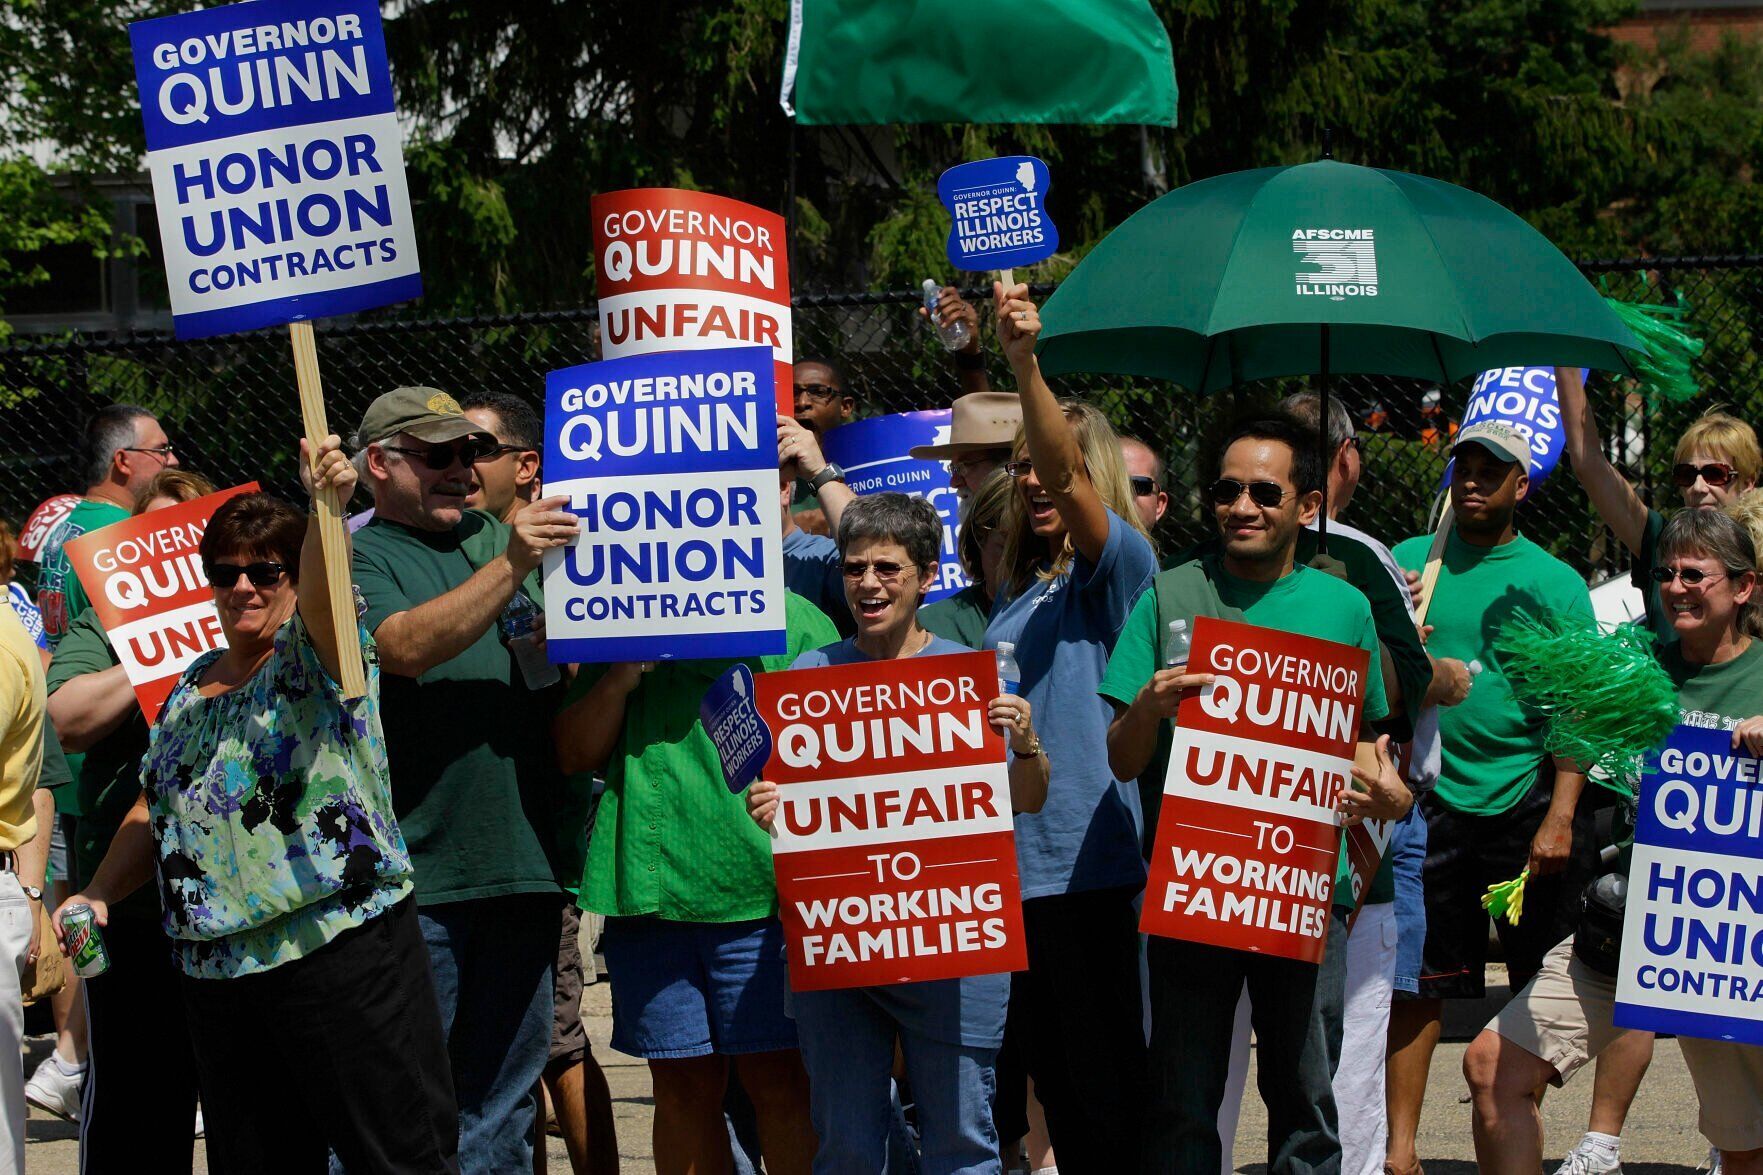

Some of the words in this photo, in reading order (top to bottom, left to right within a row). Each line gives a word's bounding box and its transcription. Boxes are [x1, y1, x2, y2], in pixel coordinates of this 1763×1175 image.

[153, 14, 363, 70] GOVERNOR
[158, 45, 371, 124] QUINN
[173, 134, 383, 204] HONOR
[954, 190, 991, 201] GOVERNOR
[992, 187, 1017, 196] QUINN:
[955, 192, 1038, 219] RESPECT
[181, 184, 393, 257] UNION
[604, 209, 774, 251] GOVERNOR
[957, 210, 1041, 237] ILLINOIS
[960, 228, 1044, 253] WORKERS
[1292, 229, 1374, 240] AFSCME
[188, 238, 397, 295] CONTRACTS
[604, 239, 775, 290] QUINN
[1296, 284, 1378, 297] ILLINOIS
[607, 303, 782, 349] UNFAIR
[561, 371, 757, 413] GOVERNOR
[559, 402, 759, 462] QUINN
[886, 469, 931, 486] QUINN
[562, 486, 761, 533] HONOR
[564, 537, 765, 587] UNION
[565, 589, 766, 622] CONTRACTS
[1210, 644, 1358, 697] GOVERNOR
[713, 696, 752, 747] RESPECT
[777, 676, 980, 721] GOVERNOR
[1200, 674, 1355, 744] QUINN
[719, 713, 758, 763] ILLINOIS
[725, 730, 763, 777] WORKERS
[777, 709, 984, 770] QUINN
[1185, 746, 1346, 810] UNFAIR
[782, 781, 999, 837] UNFAIR
[1253, 821, 1294, 854] TO
[867, 851, 921, 883] TO
[1171, 846, 1330, 902] WORKING
[795, 883, 1003, 930] WORKING
[1163, 881, 1325, 939] FAMILIES
[802, 918, 1007, 967] FAMILIES
